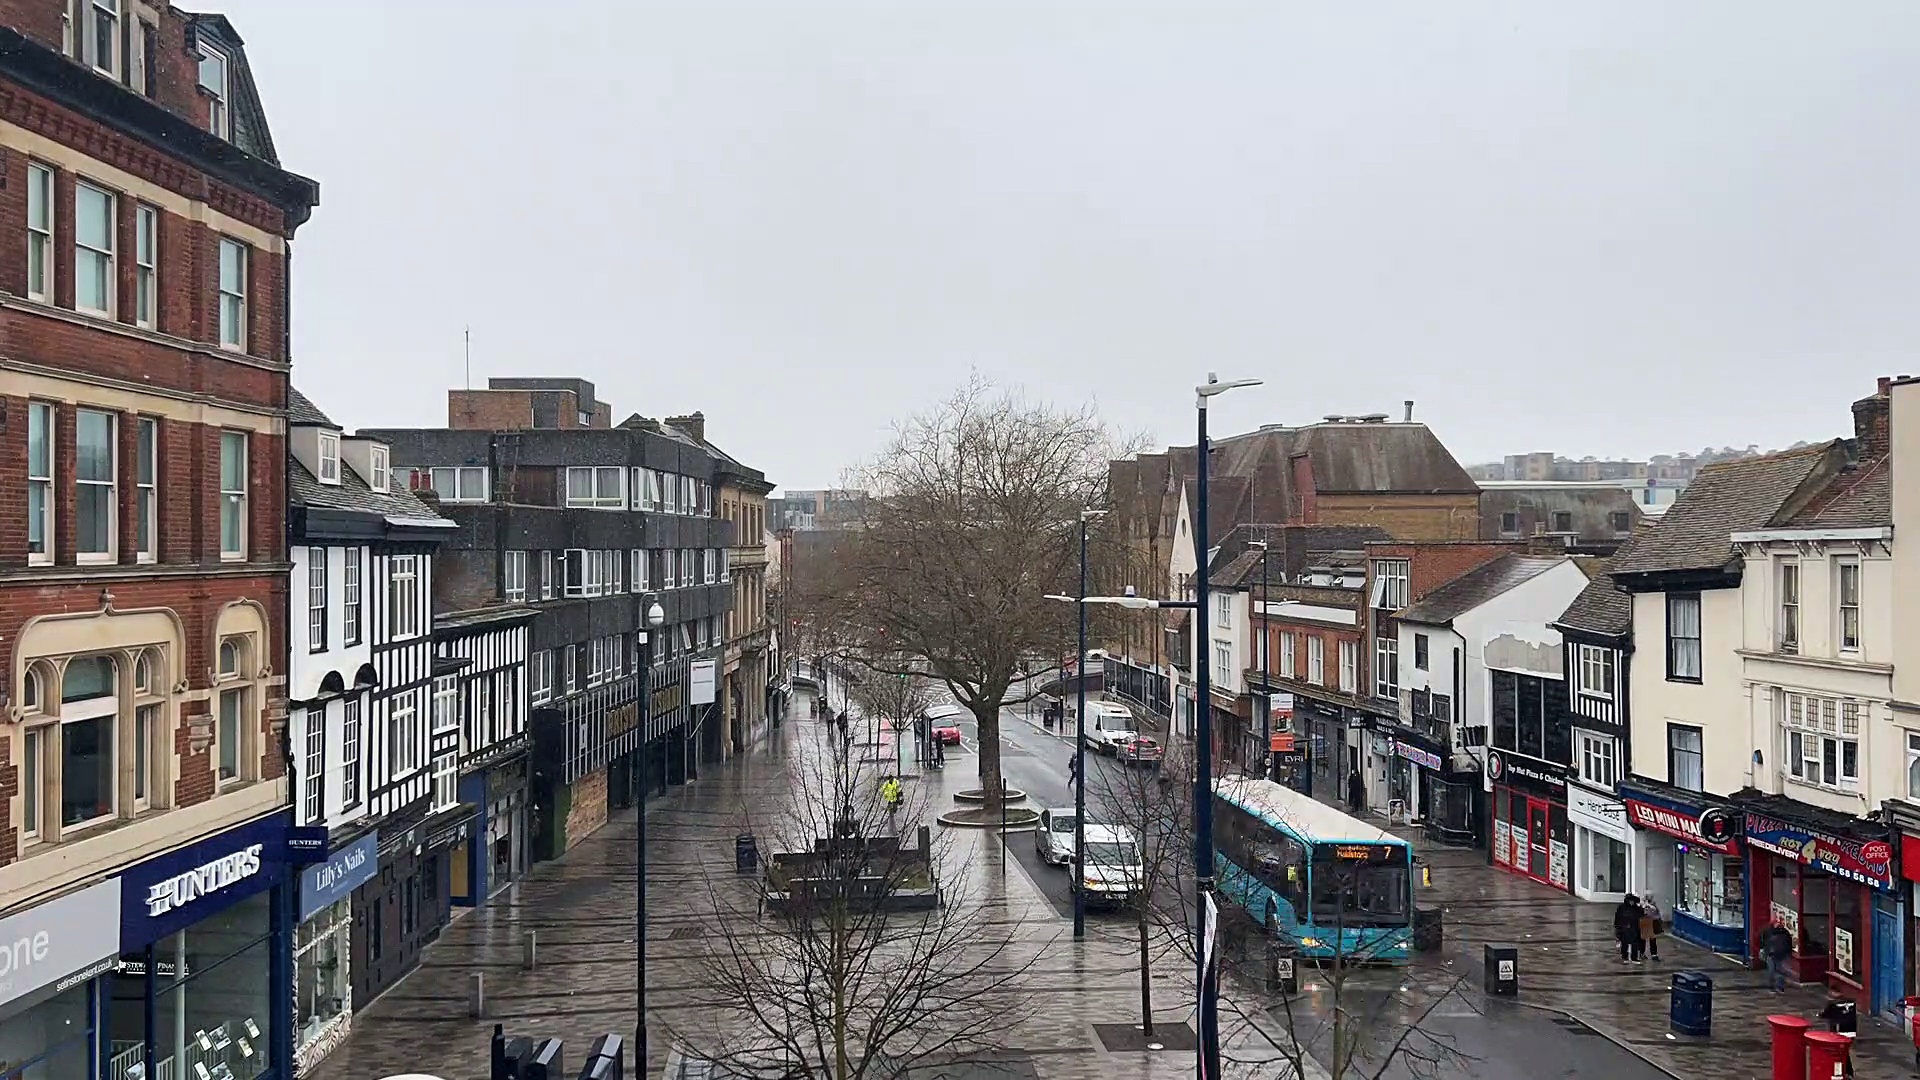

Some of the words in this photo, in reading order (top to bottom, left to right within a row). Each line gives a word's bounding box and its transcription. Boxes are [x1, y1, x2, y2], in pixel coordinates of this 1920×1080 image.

[1654, 810, 1680, 830] MINI
[1384, 846, 1392, 860] 7
[1865, 851, 1889, 860] OFFICE
[1868, 845, 1887, 853] POST
[316, 861, 343, 891] Lilly's
[344, 847, 365, 874] Nails
[146, 843, 263, 917] HUNTERS
